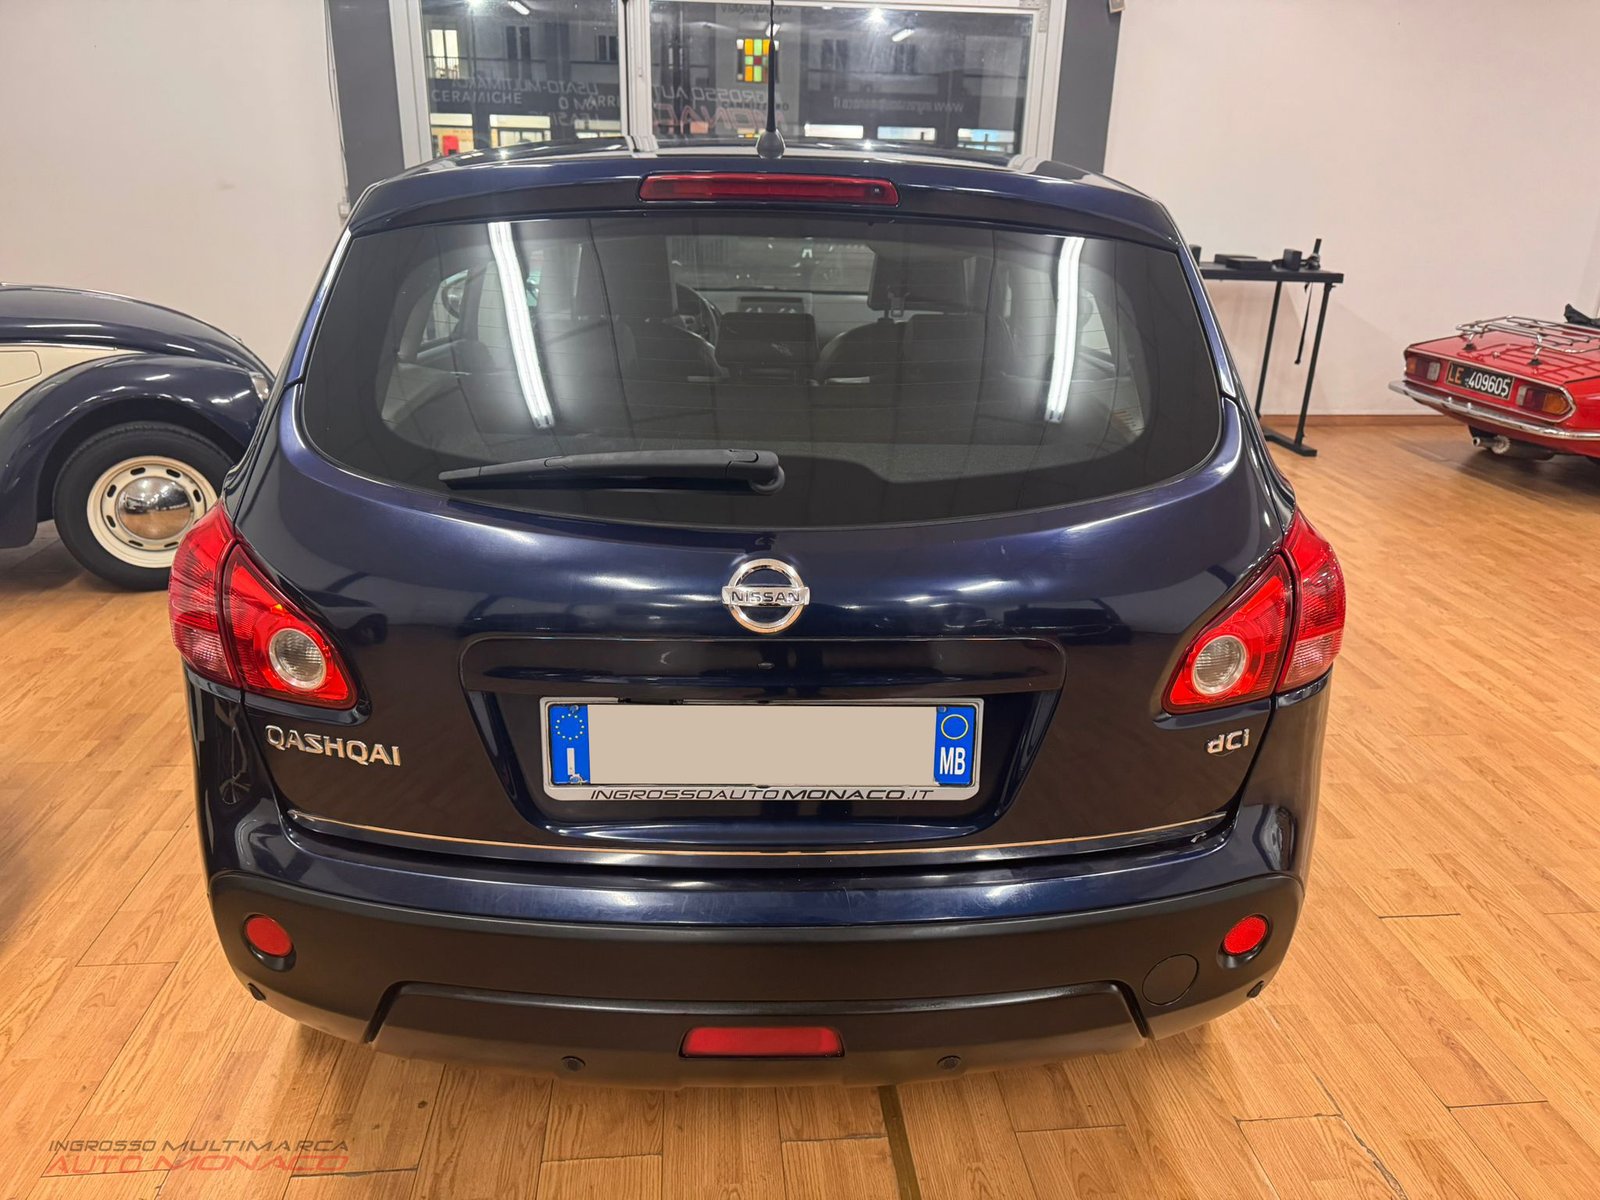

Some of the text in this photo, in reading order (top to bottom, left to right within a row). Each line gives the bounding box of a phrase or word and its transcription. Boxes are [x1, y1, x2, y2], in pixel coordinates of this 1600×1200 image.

[431, 90, 523, 105] CERAMICHE
[1447, 363, 1511, 397] LE 409605
[731, 591, 800, 603] NISSAN
[265, 724, 401, 766] QASHQAI
[1207, 728, 1250, 754] dCi
[938, 746, 967, 776] MB
